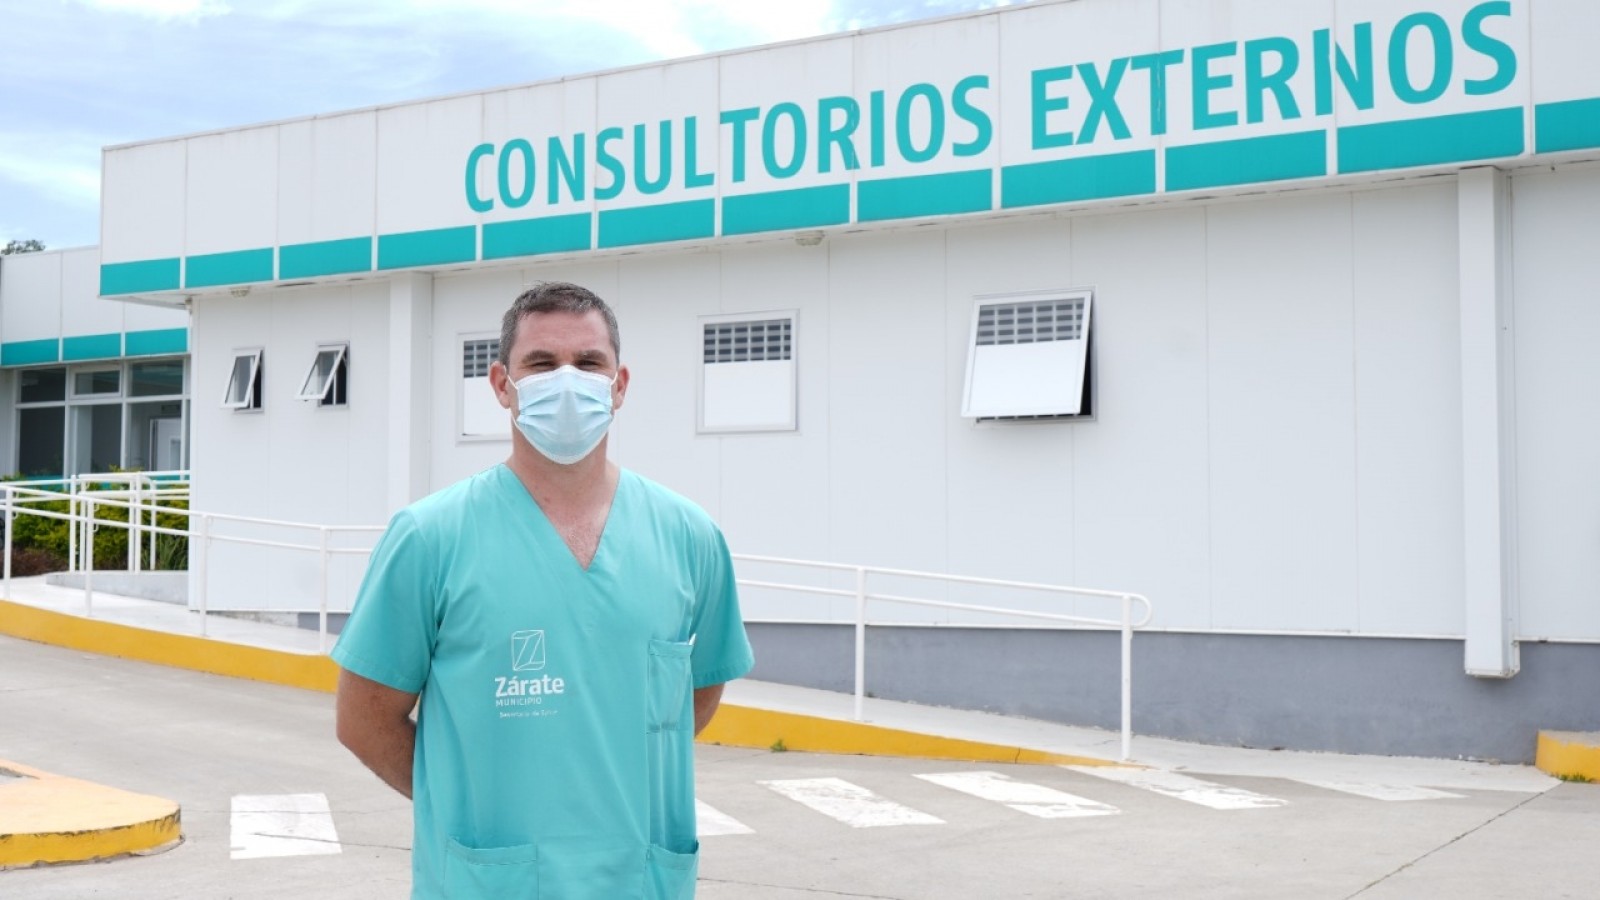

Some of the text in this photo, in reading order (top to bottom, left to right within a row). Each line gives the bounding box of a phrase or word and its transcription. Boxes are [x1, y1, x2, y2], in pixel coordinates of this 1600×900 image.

[464, 0, 1518, 213] CONSULTORIOS EXTERNOS
[494, 674, 565, 697] Zárate
[495, 697, 542, 707] MUNICIPIO
